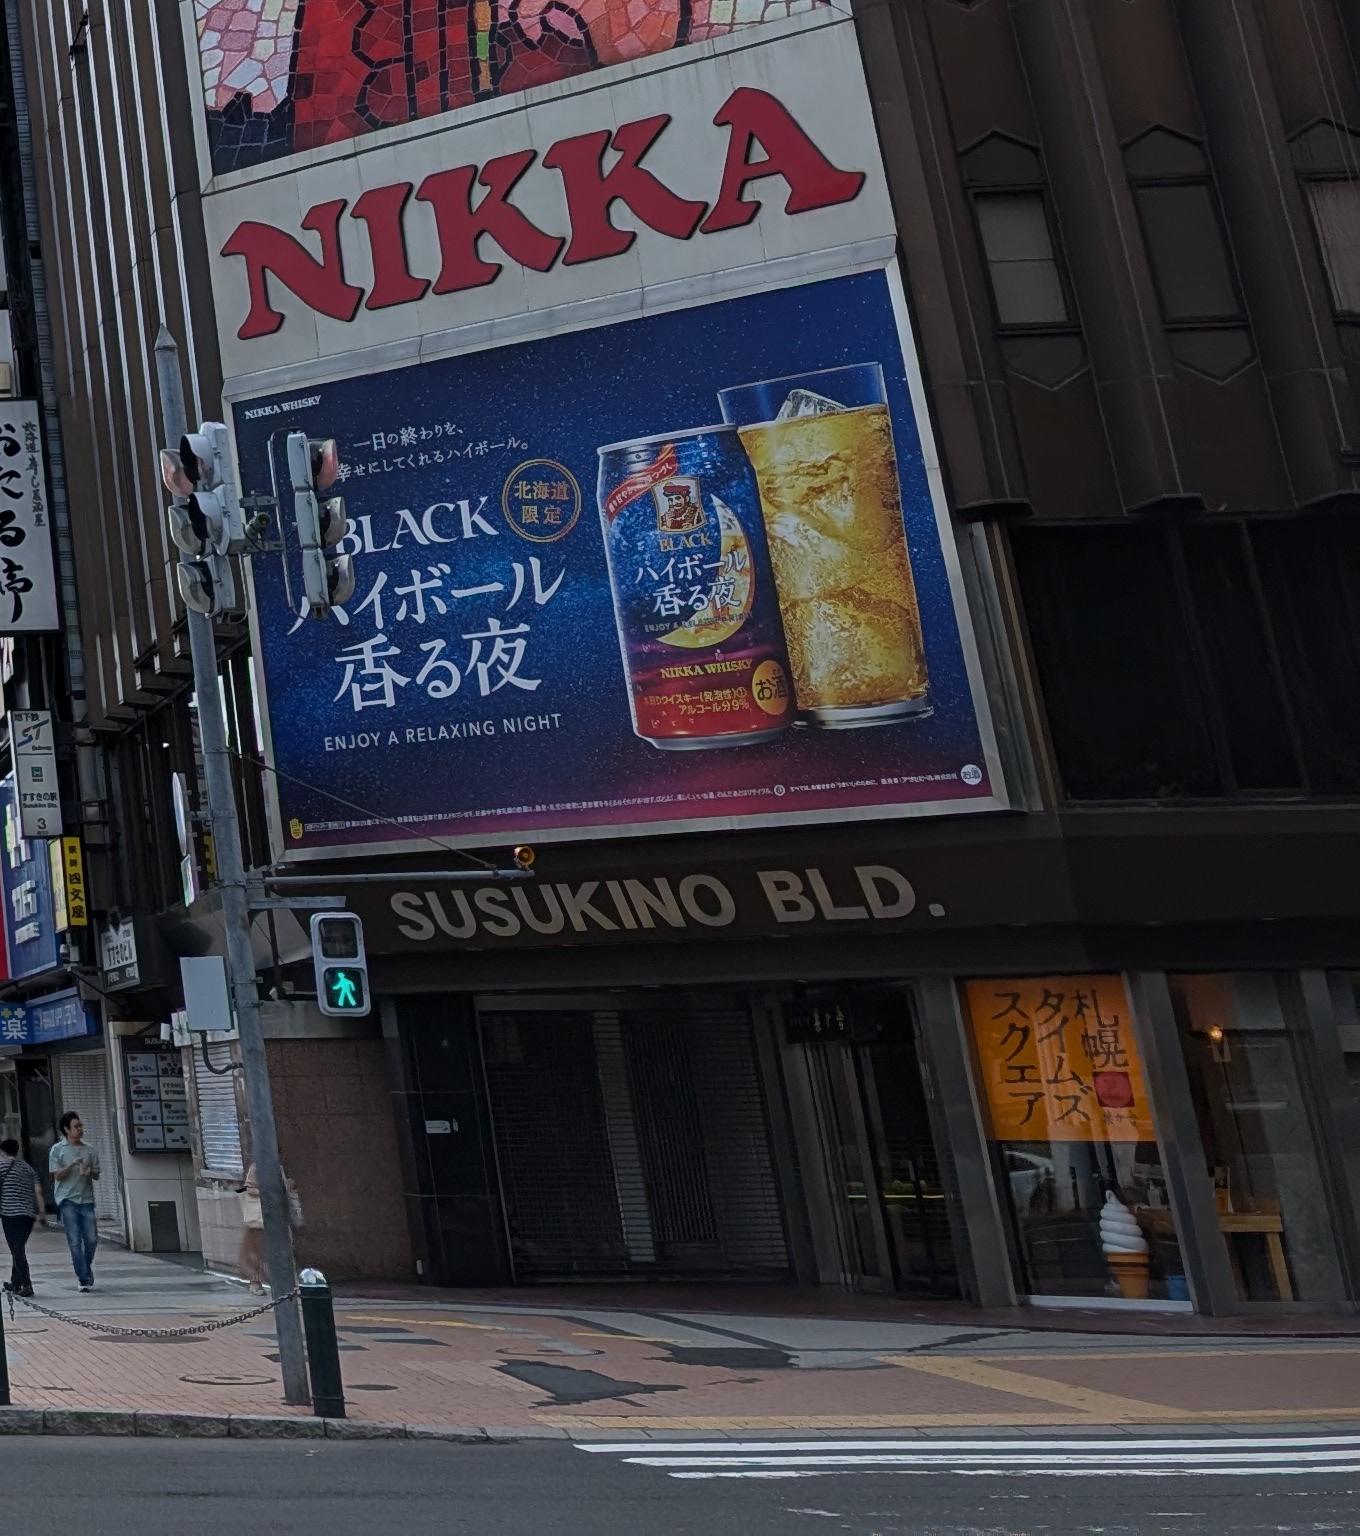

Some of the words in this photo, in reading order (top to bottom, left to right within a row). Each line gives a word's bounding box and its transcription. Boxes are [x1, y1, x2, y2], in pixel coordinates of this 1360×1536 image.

[220, 86, 866, 340] NIKKA
[244, 403, 281, 420] NIKKA
[281, 394, 322, 413] WHISKY
[353, 421, 464, 452] 一日の終わりを、
[514, 480, 570, 501] 北海道
[335, 496, 500, 557] BLACK
[521, 505, 562, 525] 限定
[659, 534, 714, 552] BLACK
[634, 550, 747, 584] ハイボール
[652, 575, 743, 617] 香る夜
[333, 618, 543, 713] 香る夜
[660, 666, 705, 679] NIKKA
[705, 658, 754, 676] WHISKY
[323, 731, 381, 752] ENJOY
[387, 729, 400, 745] A
[406, 720, 496, 744] RELAXING
[503, 712, 563, 735] NIGHT
[37, 817, 47, 830] 3
[390, 873, 736, 942] SUSUKINO
[756, 864, 946, 924] BLD.
[2, 1018, 28, 1041] 楽
[1072, 988, 1128, 1069] 札幌
[991, 992, 1045, 1127] スクエア
[1034, 988, 1092, 1127] タイムズ
